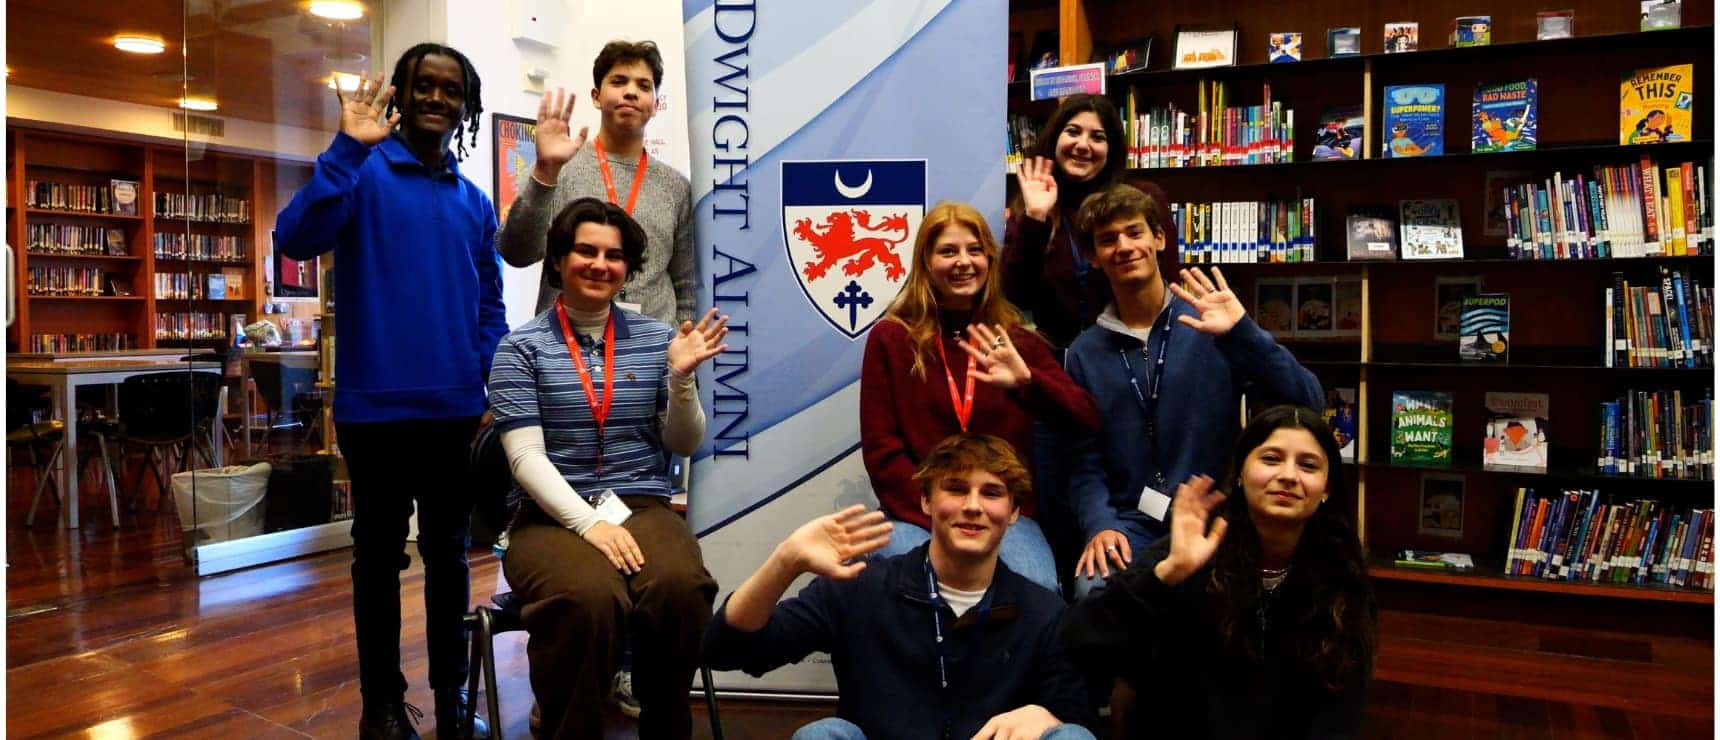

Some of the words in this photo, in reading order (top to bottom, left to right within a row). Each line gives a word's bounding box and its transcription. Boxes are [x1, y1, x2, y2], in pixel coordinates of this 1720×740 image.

[1631, 72, 1682, 87] REMEMBER
[1500, 90, 1527, 100] WASTE
[1635, 83, 1676, 101] THIS
[713, 0, 757, 230] DWIGHT
[1641, 167, 1654, 193] WHAT
[1645, 202, 1655, 218] EAT
[1398, 415, 1446, 428] ANIMALS
[1404, 430, 1438, 442] WANT
